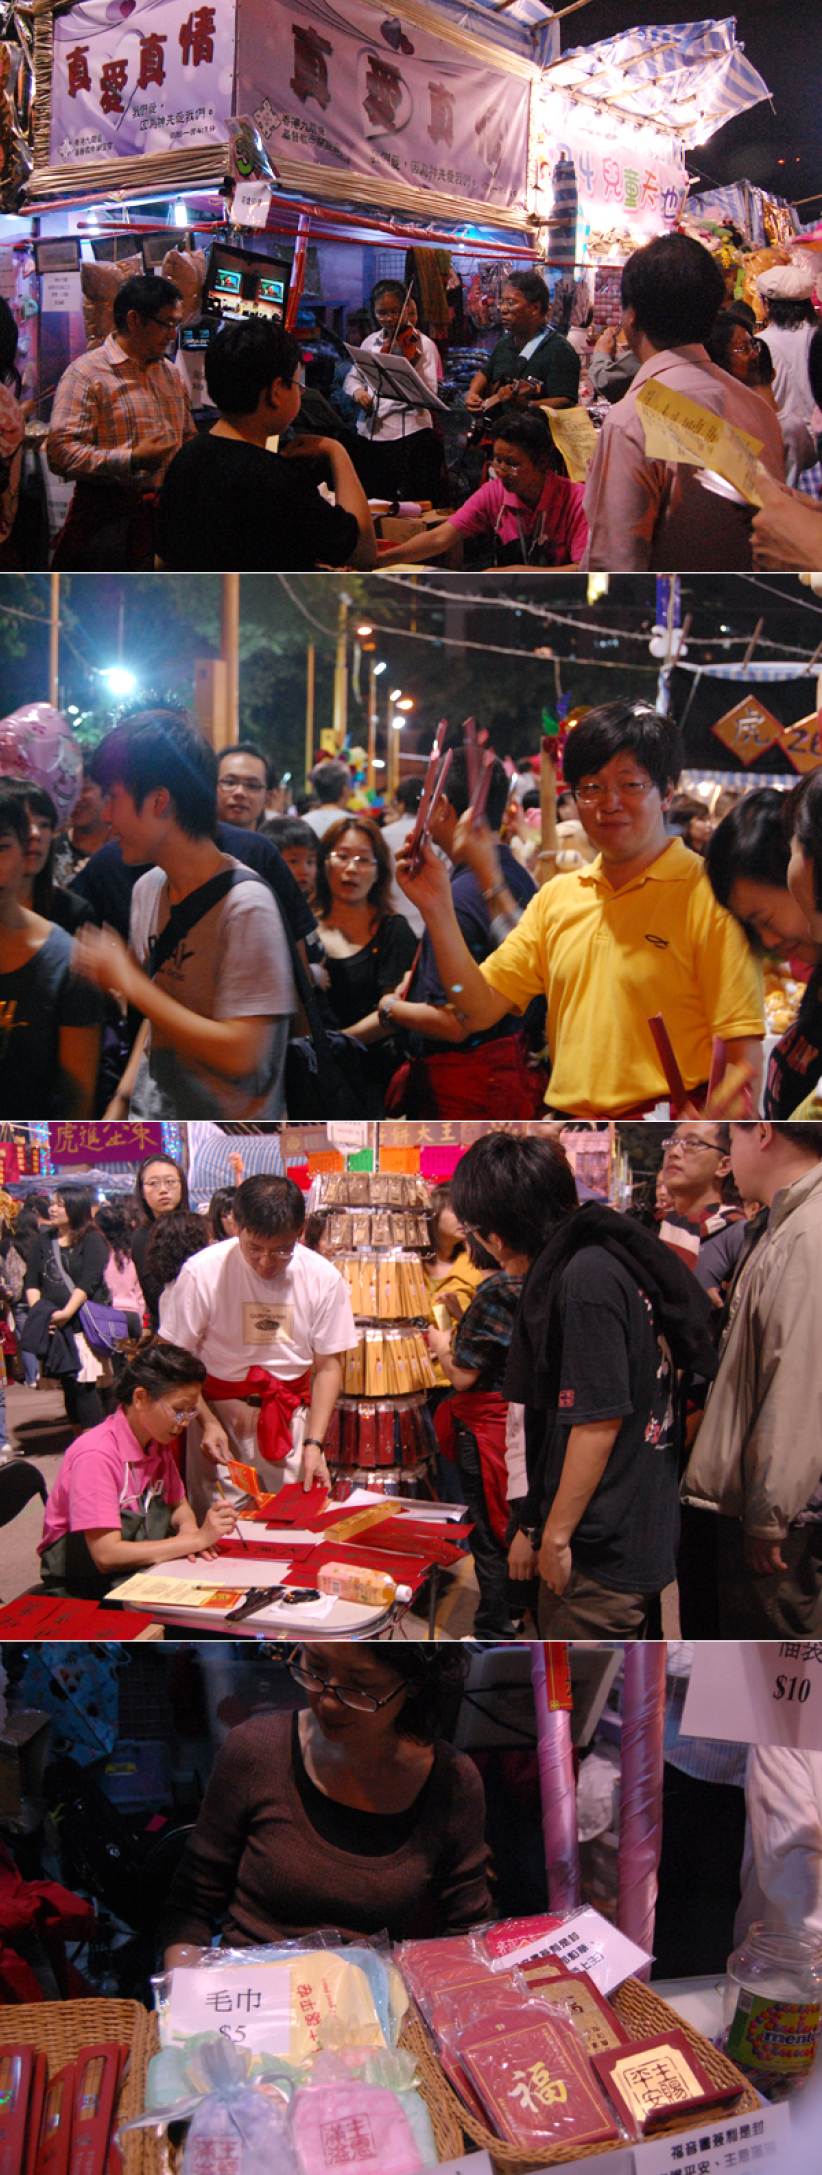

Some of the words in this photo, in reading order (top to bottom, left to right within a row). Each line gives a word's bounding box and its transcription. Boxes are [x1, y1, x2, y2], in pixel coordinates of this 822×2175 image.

[66, 6, 216, 115] 真愛真情
[730, 707, 770, 746] 虎
[773, 1674, 811, 1703] $10
[205, 1988, 262, 2013] 毛巾
[219, 2024, 247, 2043] $5
[507, 2061, 568, 2113] 福
